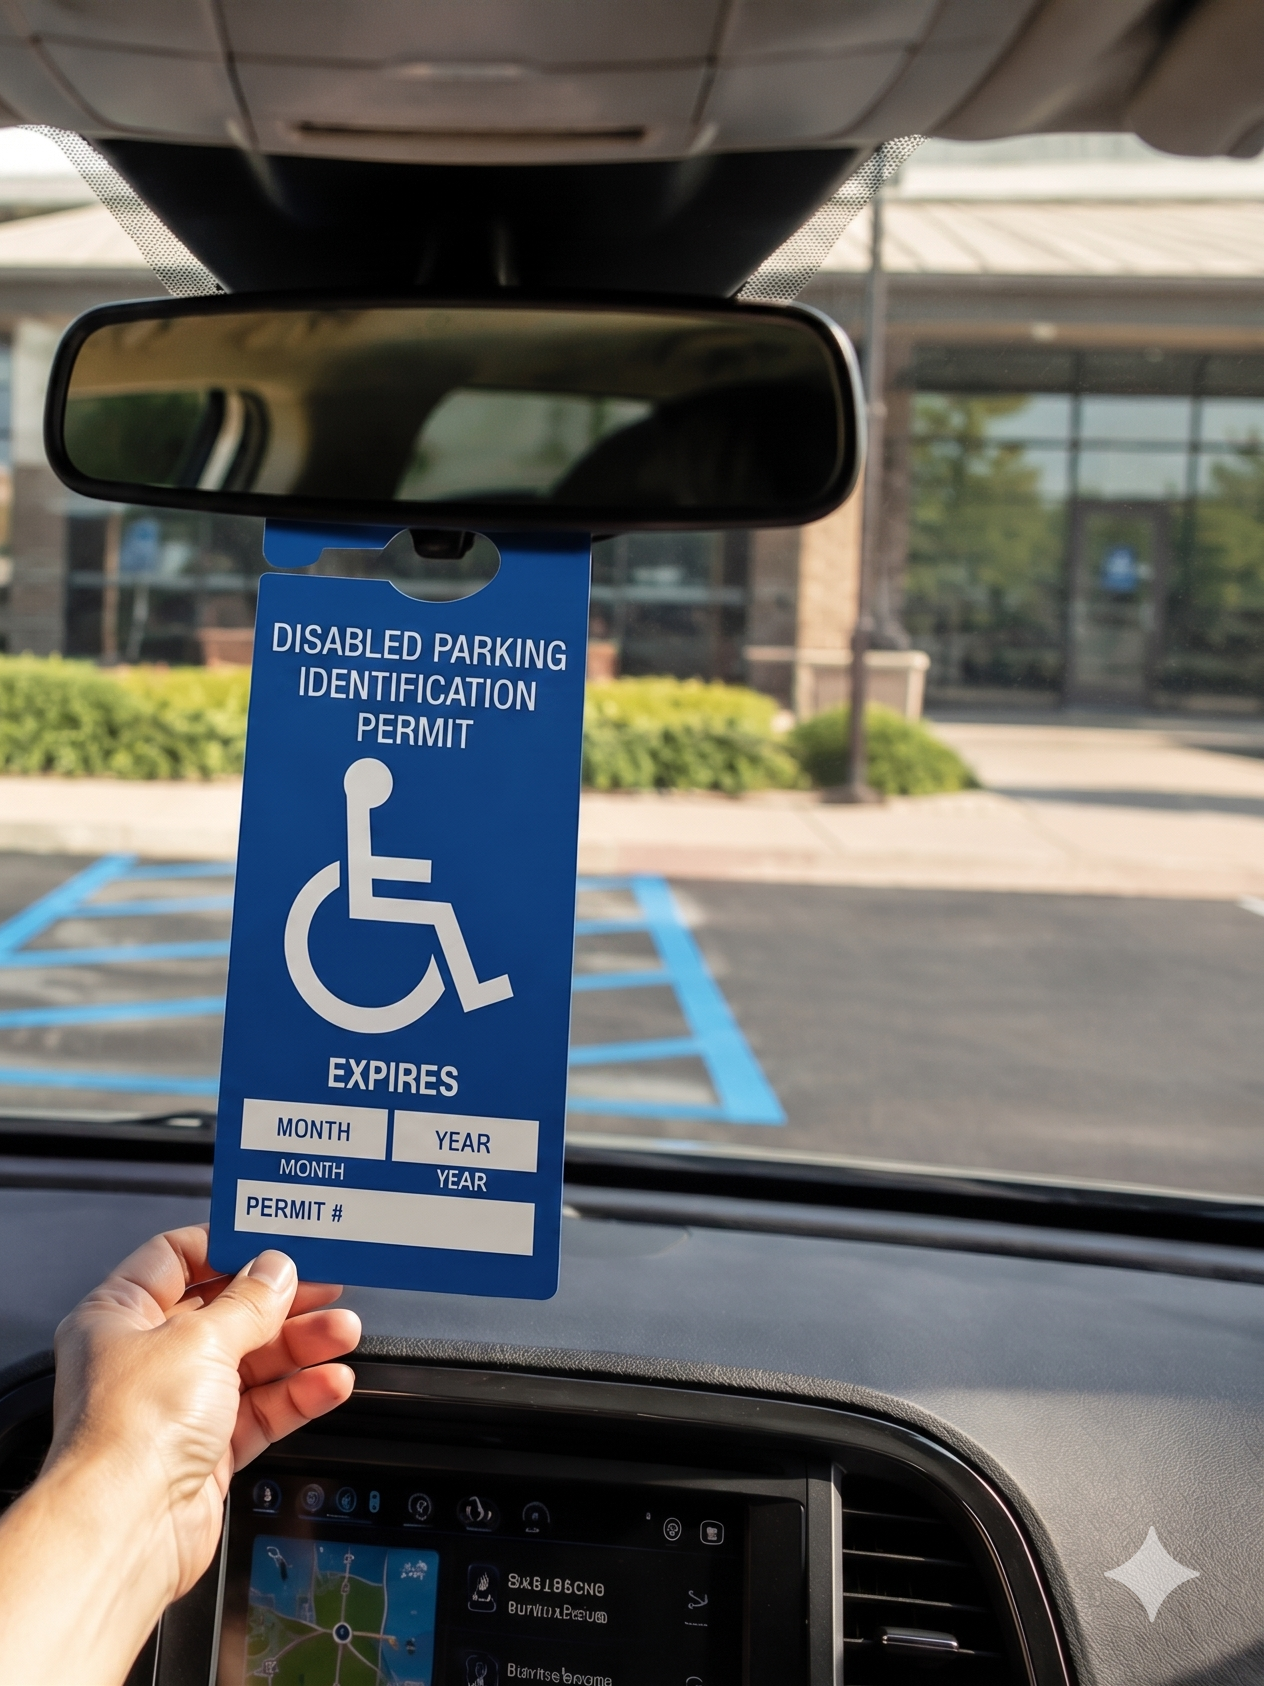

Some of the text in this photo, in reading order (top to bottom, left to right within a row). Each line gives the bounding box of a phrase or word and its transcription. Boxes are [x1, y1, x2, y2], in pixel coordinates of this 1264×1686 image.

[272, 622, 567, 671] DISABLED PARKING
[299, 666, 537, 711] IDENTIFICATION
[357, 712, 474, 749] PERMIT
[328, 1057, 459, 1097] EXPIRES
[276, 1117, 351, 1142] MONTH
[435, 1130, 491, 1154] YEAR
[279, 1158, 345, 1180] MONTH
[436, 1169, 487, 1192] YEAR
[246, 1196, 343, 1223] PERMIT #
